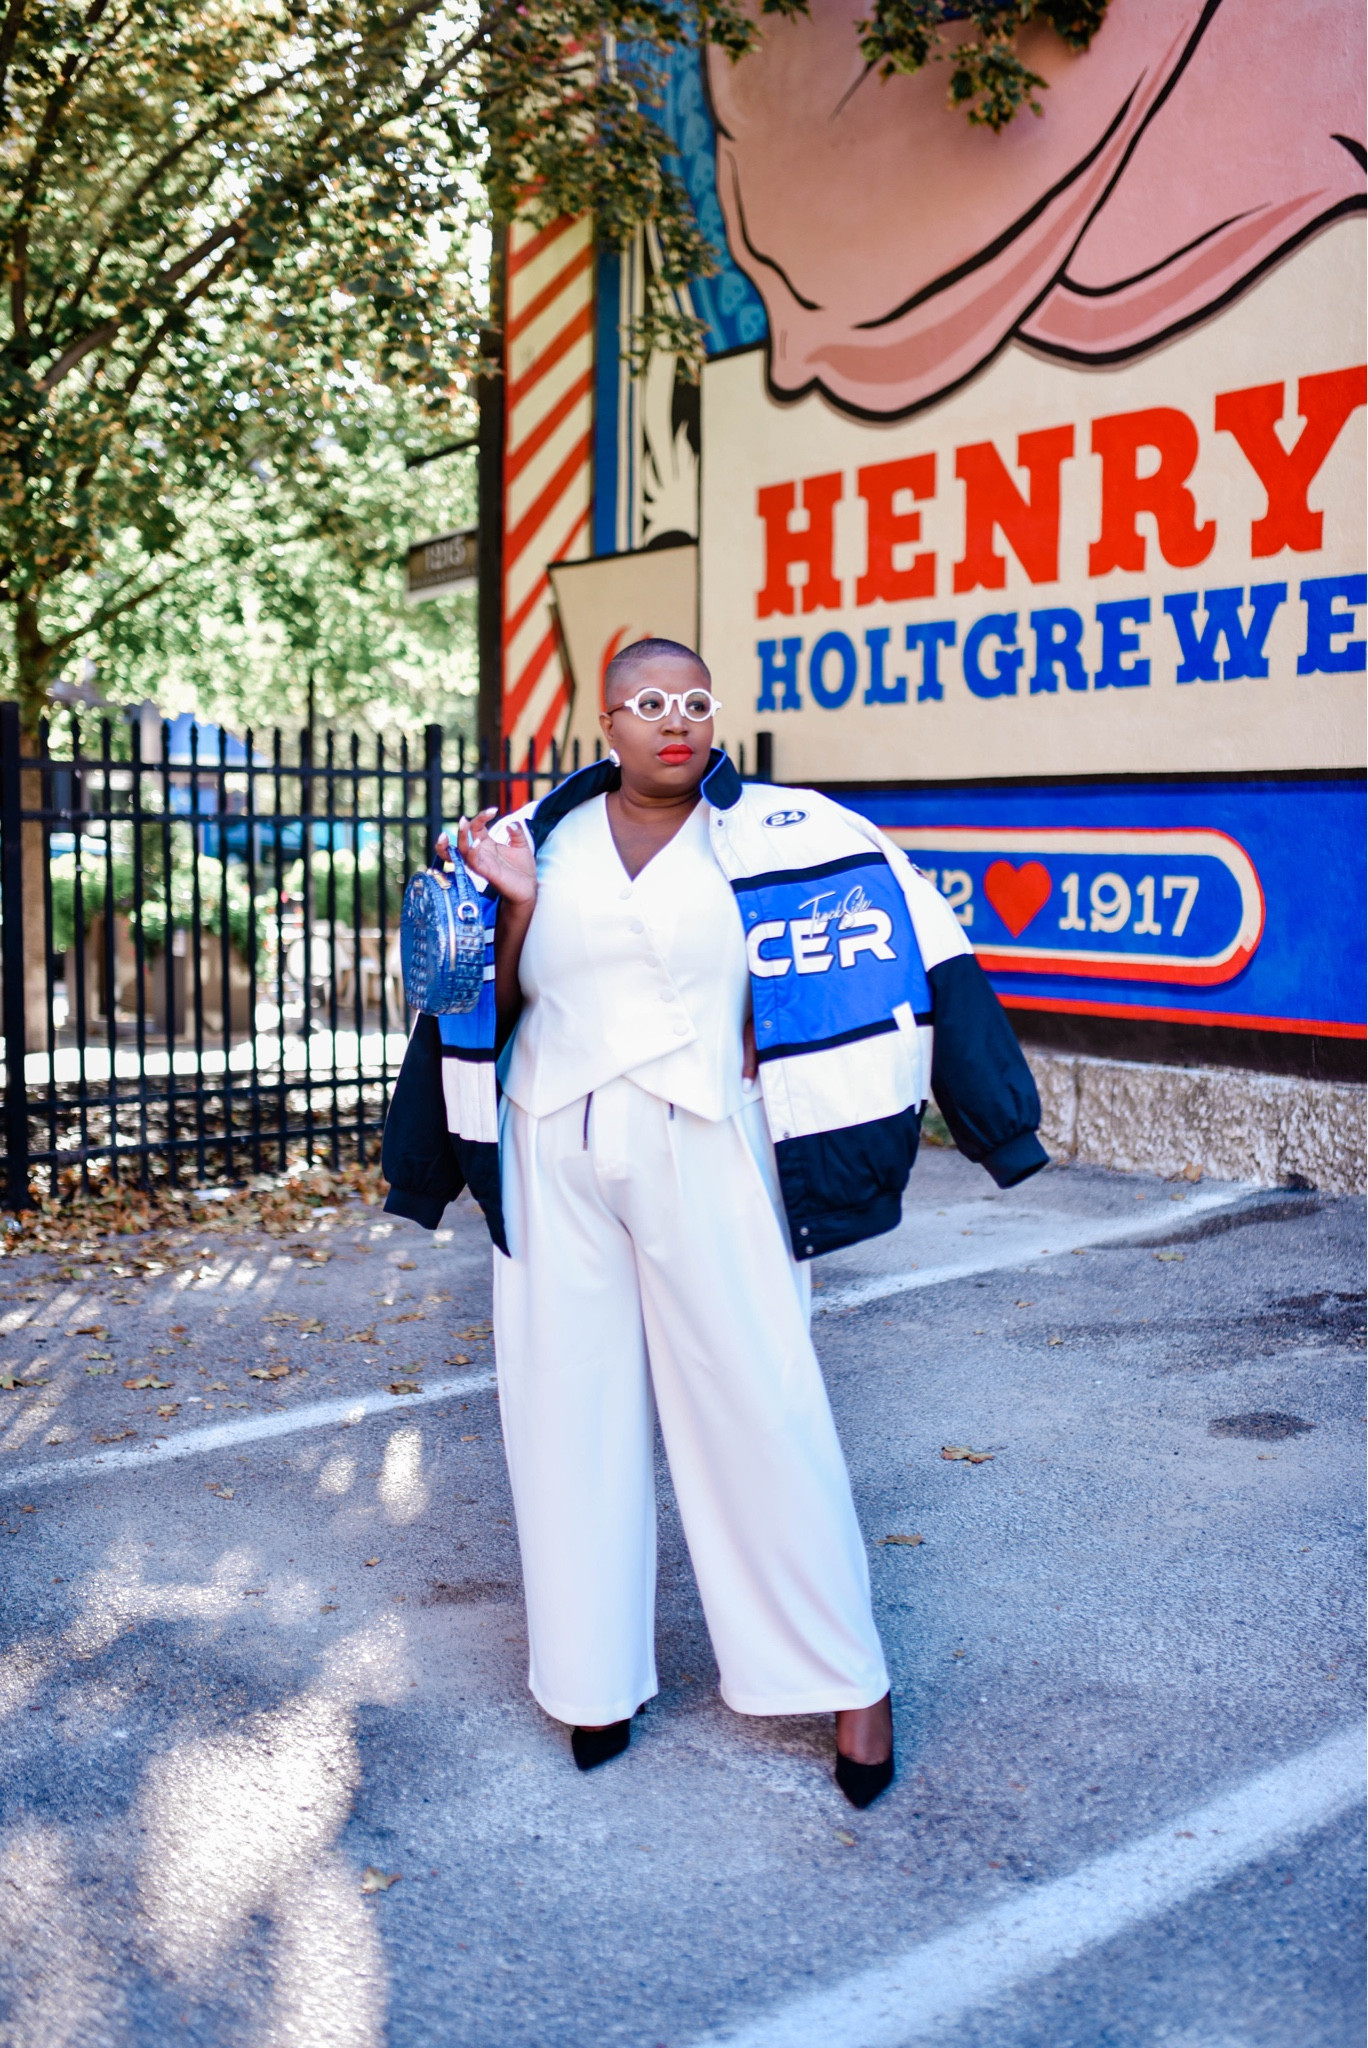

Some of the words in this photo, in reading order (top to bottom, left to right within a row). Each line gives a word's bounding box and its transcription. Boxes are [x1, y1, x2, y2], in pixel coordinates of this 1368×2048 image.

[756, 364, 1367, 621] HENRY
[755, 573, 1367, 714] HOLTGREWE
[770, 810, 804, 826] 24
[1058, 873, 1200, 937] 1917
[745, 907, 898, 978] CER
